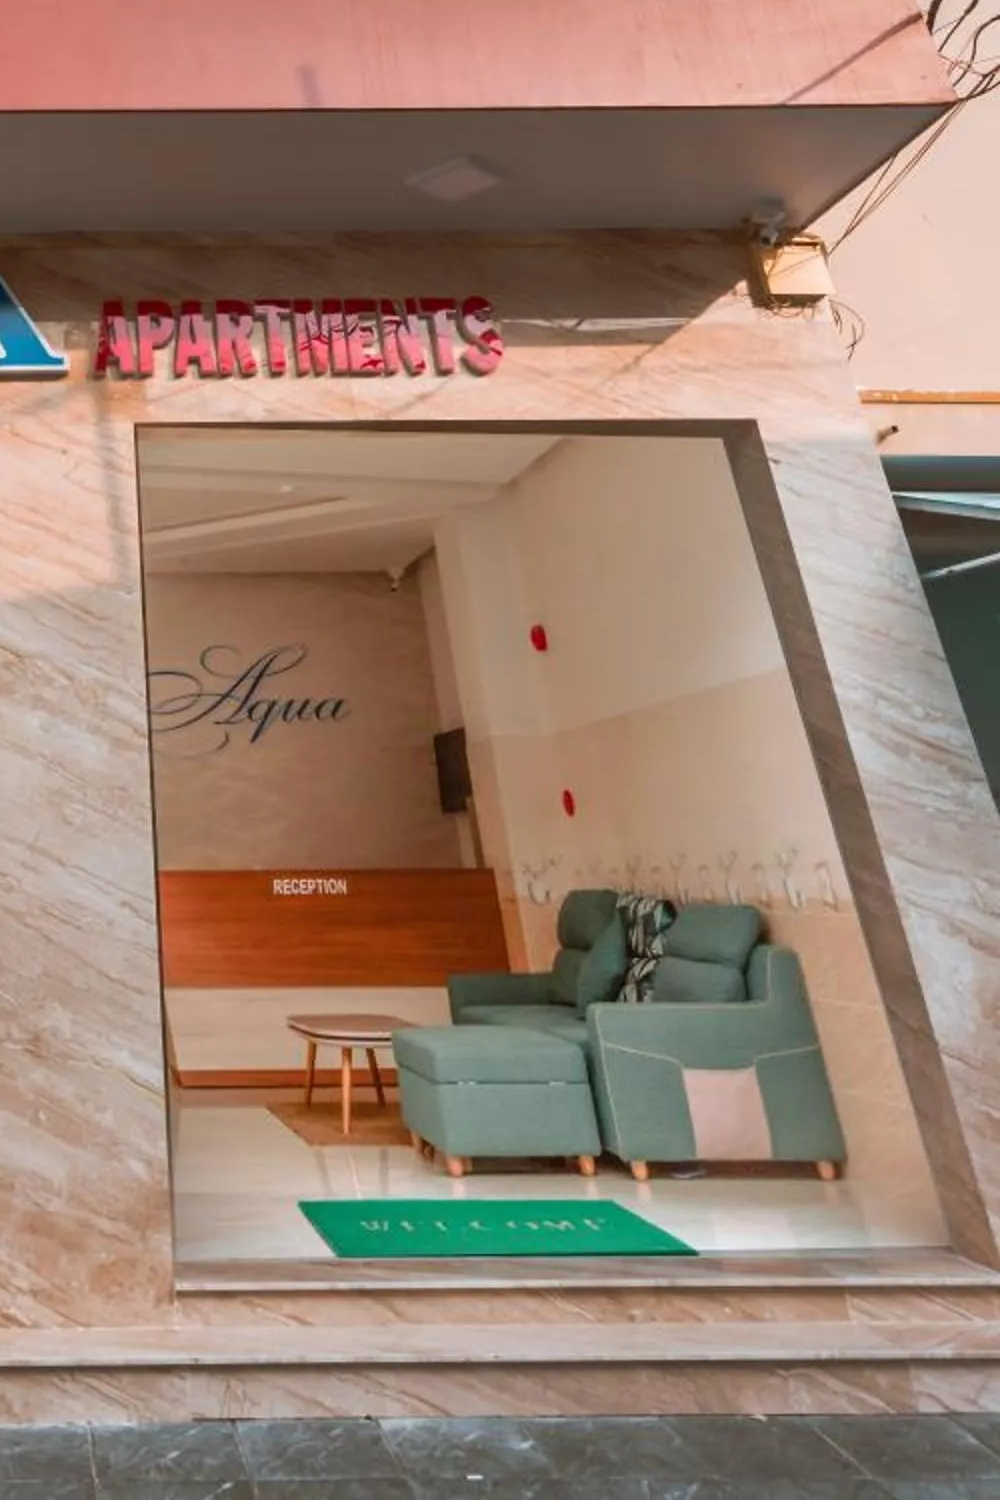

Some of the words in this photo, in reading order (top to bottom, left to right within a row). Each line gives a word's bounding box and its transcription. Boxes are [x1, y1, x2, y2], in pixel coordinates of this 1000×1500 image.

[95, 295, 504, 377] APARTMENTS
[148, 644, 350, 750] Aqua
[273, 878, 348, 895] RECEPTION
